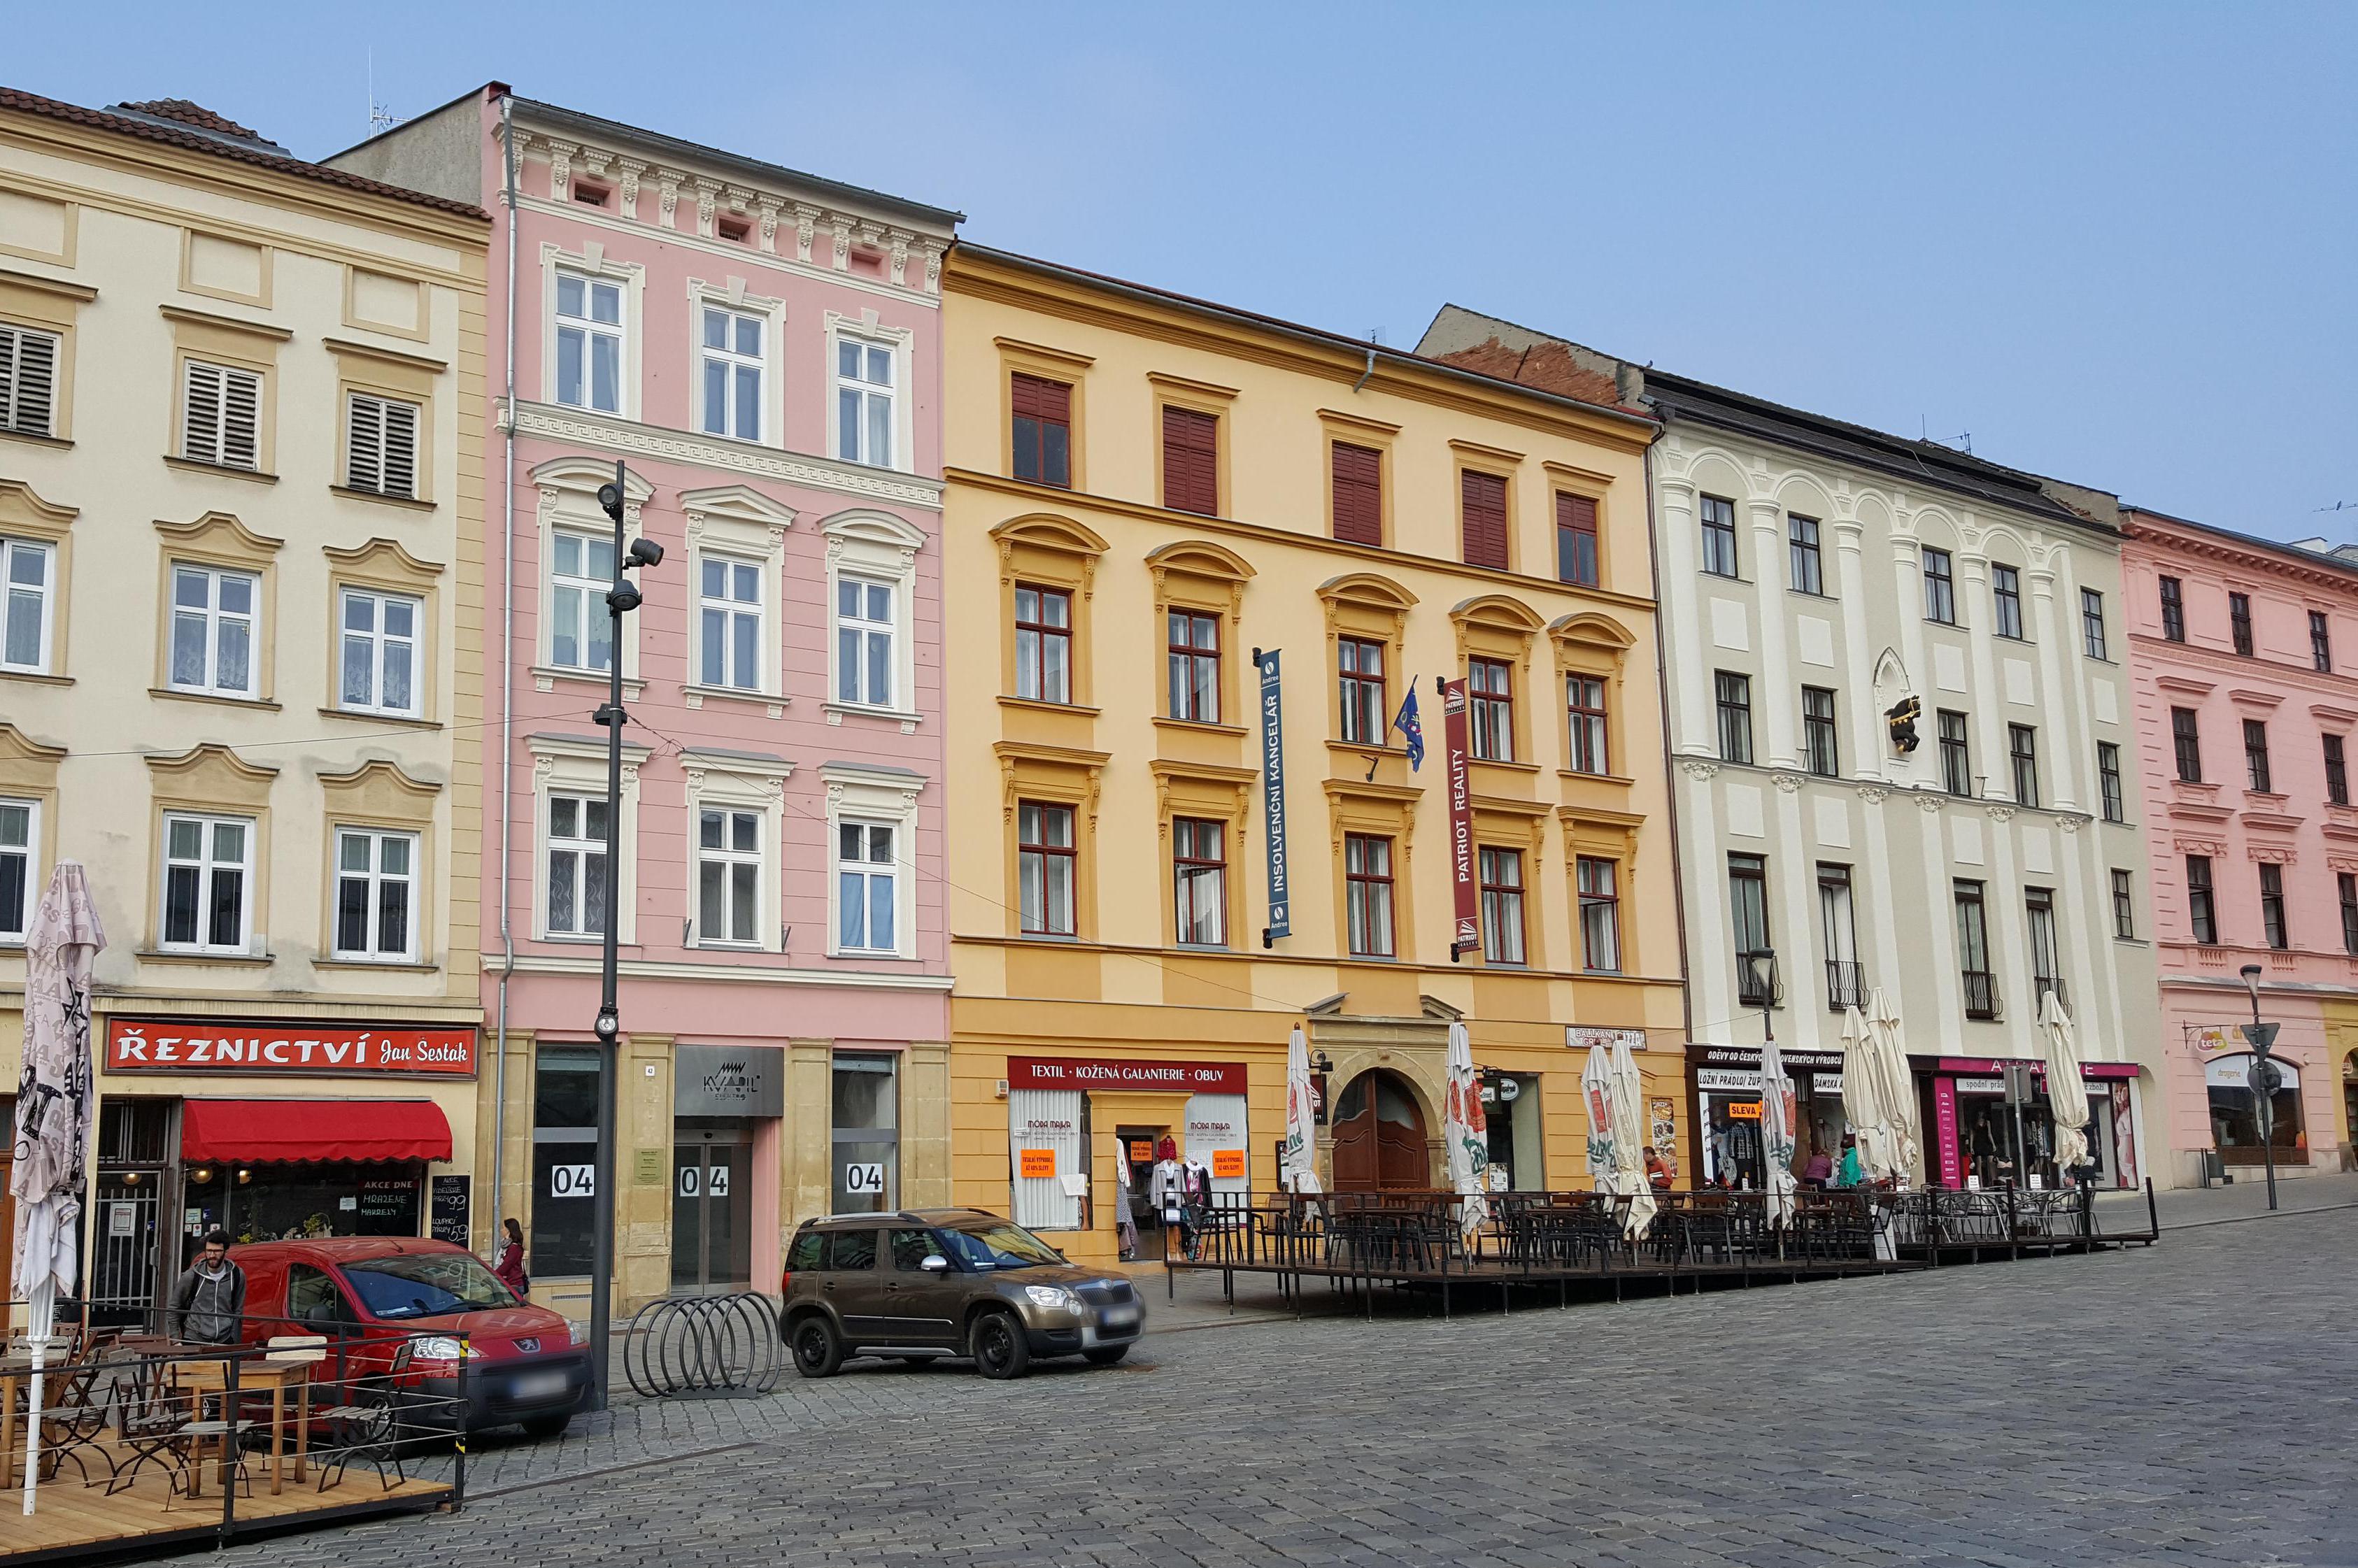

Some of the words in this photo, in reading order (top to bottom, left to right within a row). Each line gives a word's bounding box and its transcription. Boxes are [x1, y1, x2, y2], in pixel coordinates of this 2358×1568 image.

[1445, 699, 1465, 709] PATRIOT
[1265, 694, 1280, 781] KANCELÁŘ
[1451, 749, 1466, 811] REALITY
[1268, 785, 1284, 892] INSOLVENČNÍ
[1456, 820, 1470, 883] PATRIOT
[1457, 934, 1477, 943] PATRIOT
[1575, 1029, 1612, 1039] BALLKAN
[118, 1028, 371, 1064] ŘEZNICTVÍ
[381, 1039, 411, 1064] Jan
[417, 1036, 468, 1062] Šesták
[2201, 1038, 2224, 1048] teta
[1707, 1049, 1729, 1060] ODĚVY
[1729, 1051, 1738, 1060] OD
[1739, 1050, 1763, 1062] ČESKÝC
[1781, 1054, 1814, 1064] OVENSKÝCH
[1816, 1054, 1842, 1065] VÝROBCŮ
[1031, 1064, 1065, 1078] TEXTIL
[1076, 1064, 1119, 1079] KOŽENÁ
[1123, 1067, 1185, 1081] GALANTERIE
[1195, 1069, 1223, 1081] OBUV
[1699, 1071, 1719, 1085] LOŽNÍ
[1814, 1076, 1839, 1089] DÁMSKÁ
[1966, 1080, 1987, 1089] spodní
[1991, 1080, 2004, 1090] prád
[1731, 1106, 1756, 1115] SLEVA
[553, 1167, 592, 1194] 04
[848, 1165, 881, 1190] 04
[448, 1195, 467, 1211] 99
[361, 1208, 396, 1216] MAKRELY
[448, 1224, 469, 1241] 59
